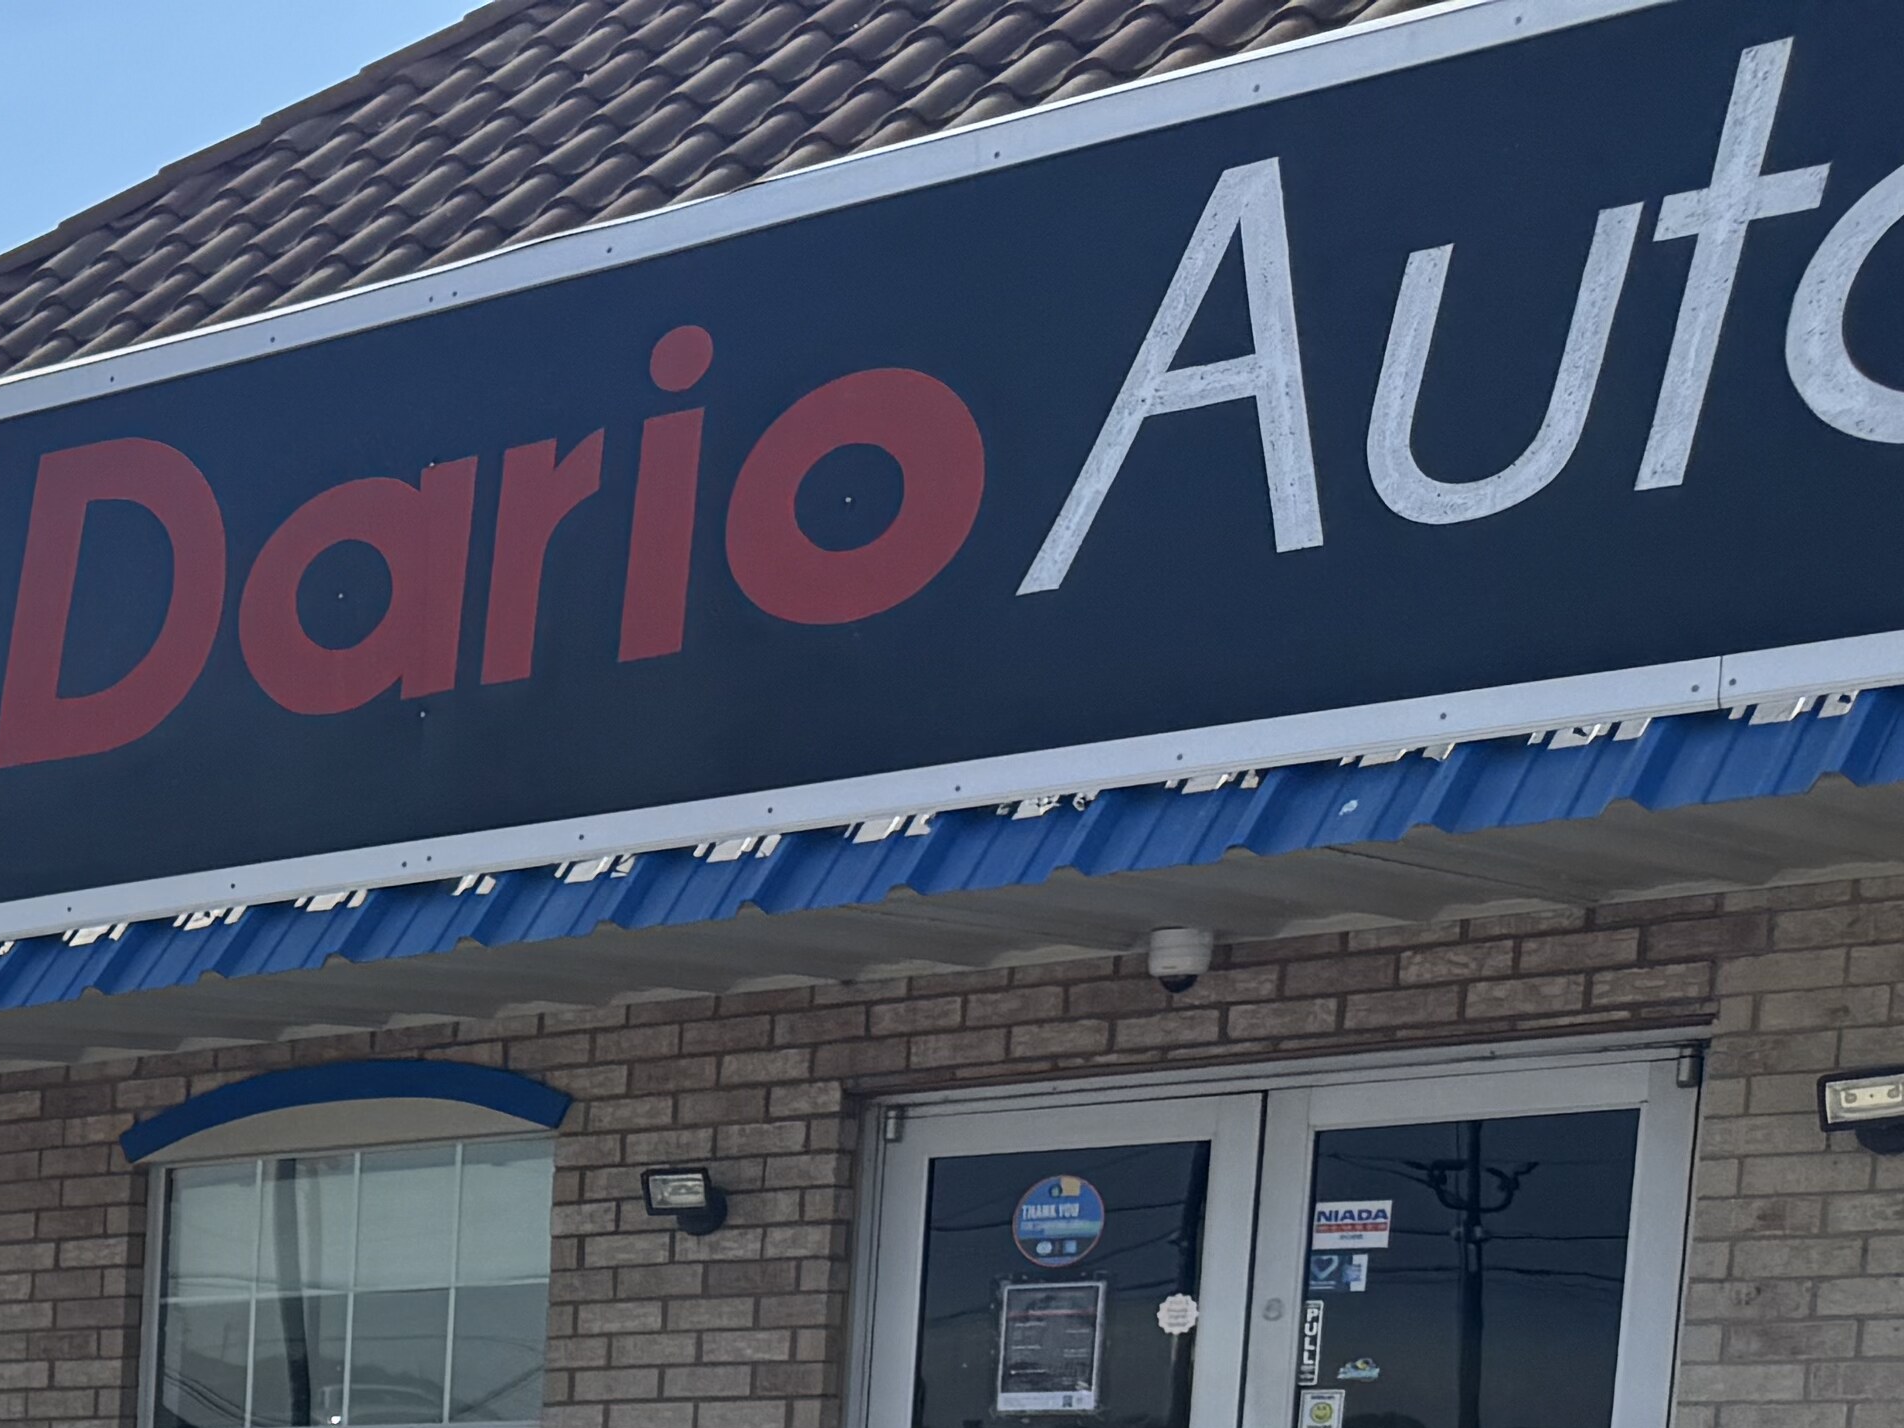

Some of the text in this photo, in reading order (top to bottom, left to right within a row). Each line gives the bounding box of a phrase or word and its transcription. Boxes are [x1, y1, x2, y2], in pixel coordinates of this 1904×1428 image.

[1022, 1203, 1080, 1220] THANK YOU
[1316, 1208, 1389, 1222] NIADA
[1302, 1308, 1319, 1365] PULL
